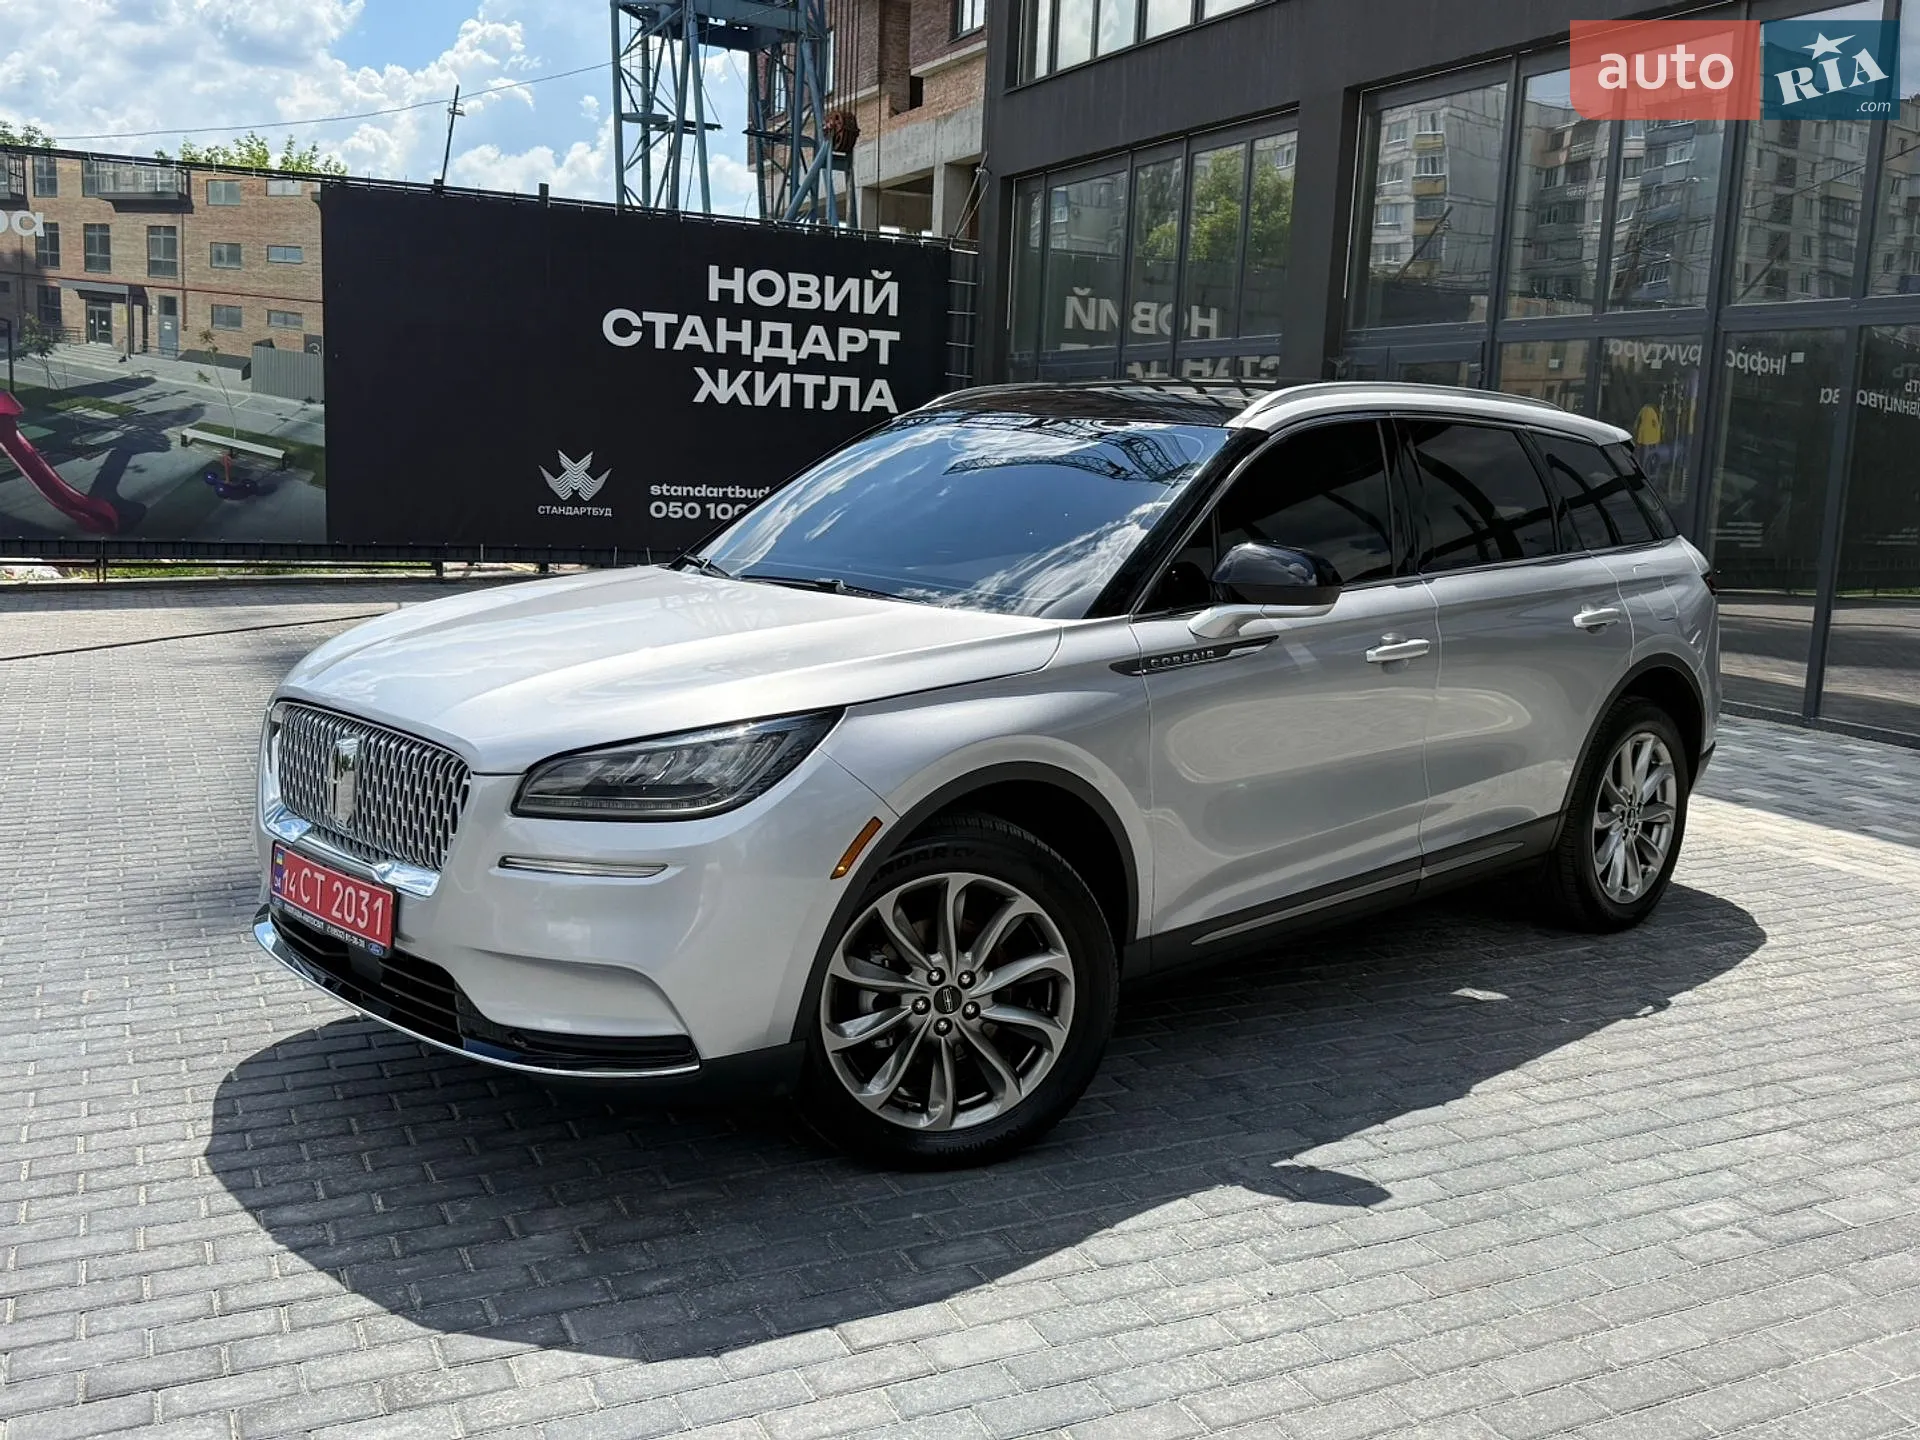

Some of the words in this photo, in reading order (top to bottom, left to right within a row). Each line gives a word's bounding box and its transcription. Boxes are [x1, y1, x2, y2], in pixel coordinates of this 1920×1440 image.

[708, 264, 899, 317] НОВИЙ
[602, 307, 900, 366] СТАНДАРТ
[693, 366, 899, 414] ЖИТЛА
[537, 505, 613, 518] СТАНДАРТБУД
[649, 501, 701, 520] 050
[1150, 650, 1215, 667] CORSAIR
[331, 881, 384, 936] 2031
